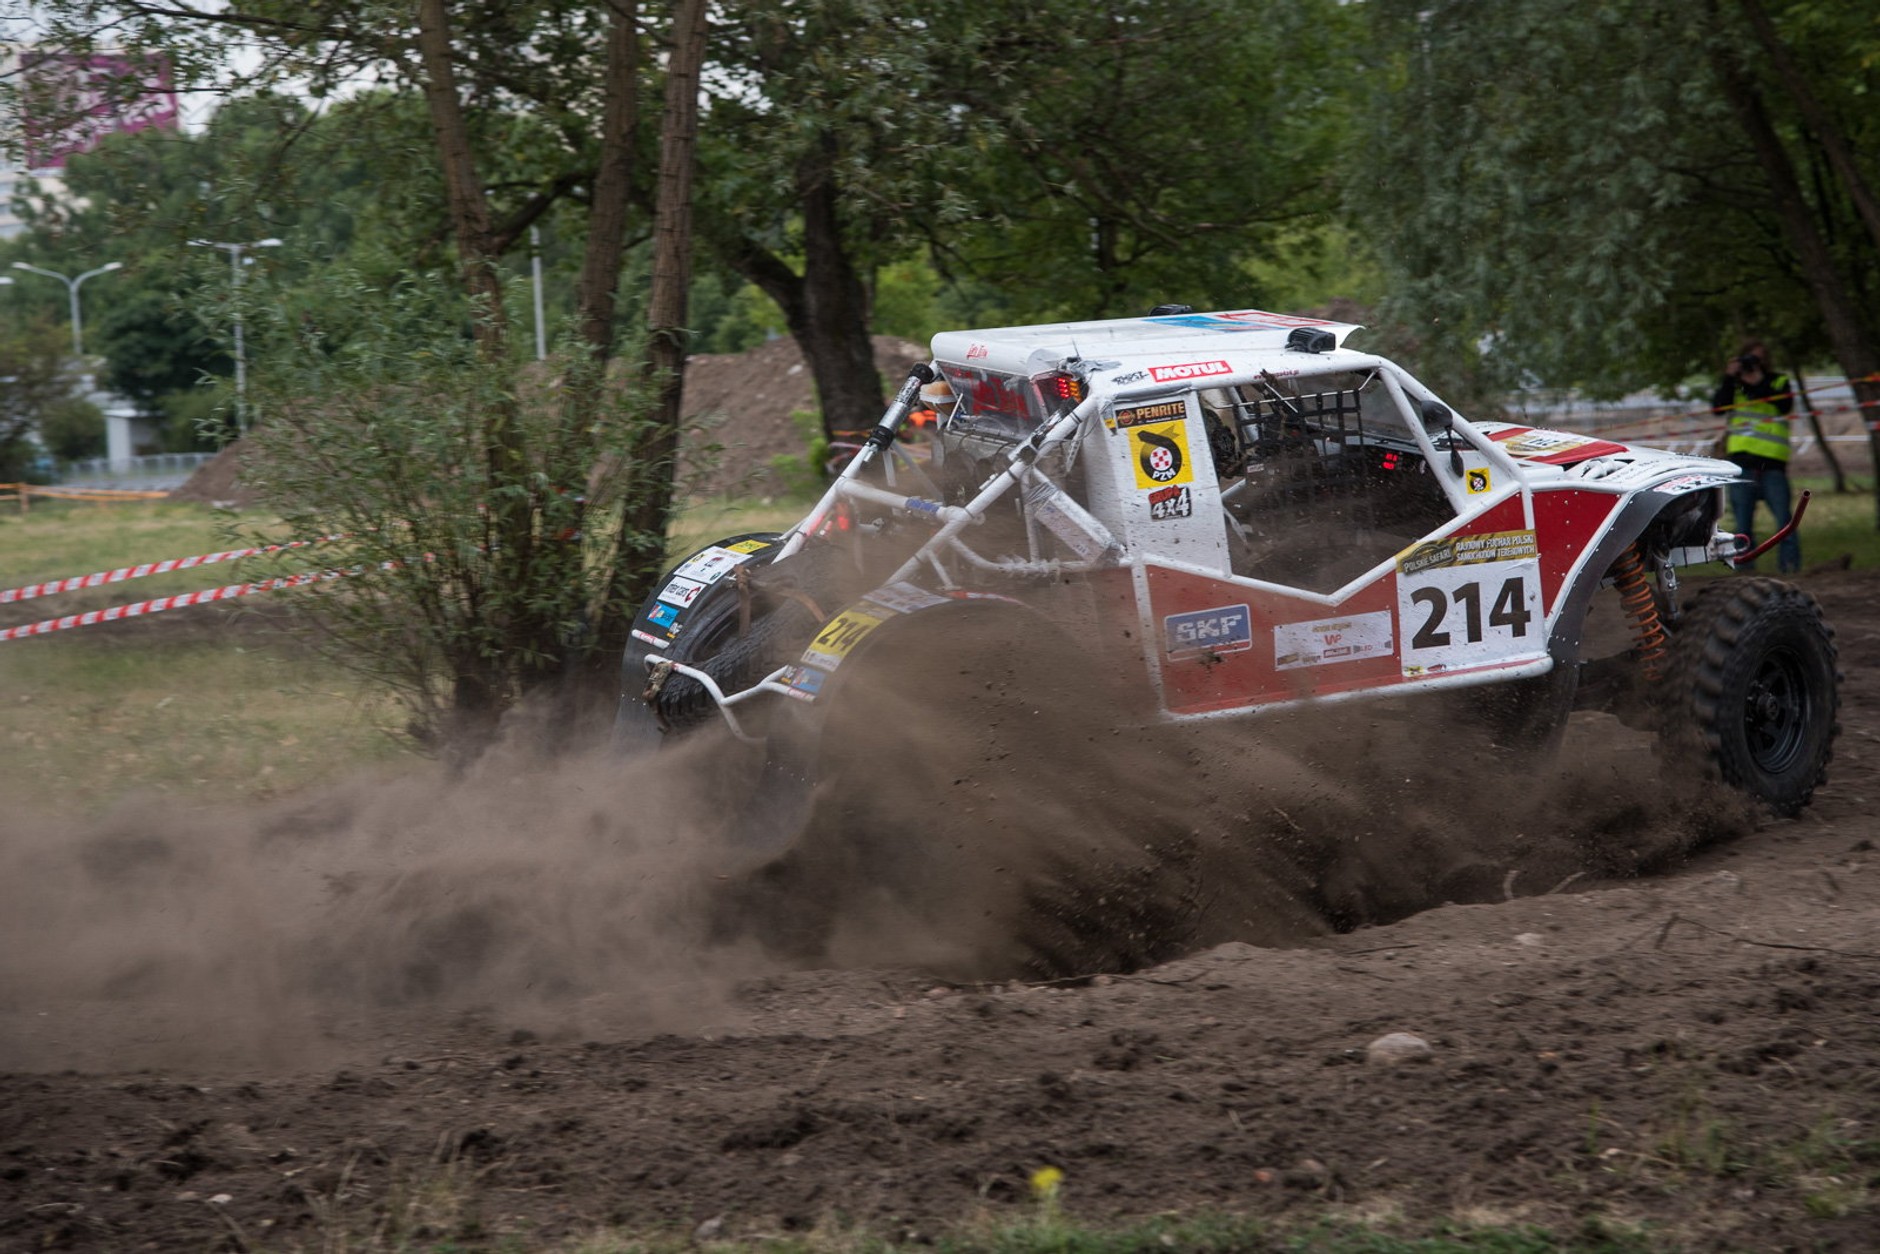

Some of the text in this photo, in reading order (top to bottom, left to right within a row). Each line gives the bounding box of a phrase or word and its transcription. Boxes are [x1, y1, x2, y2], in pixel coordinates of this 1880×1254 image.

[1154, 361, 1229, 381] MOTUL
[1136, 401, 1186, 420] PENRITE
[1151, 467, 1177, 482] PZM
[1455, 534, 1534, 551] RAJDOWY PUCHAR POLSKI
[1497, 545, 1536, 558] TERENOWYCH
[1403, 549, 1451, 573] POLSKIE SAFARI
[1410, 576, 1532, 650] 214
[817, 618, 870, 651] 214
[1176, 614, 1243, 643] SKF
